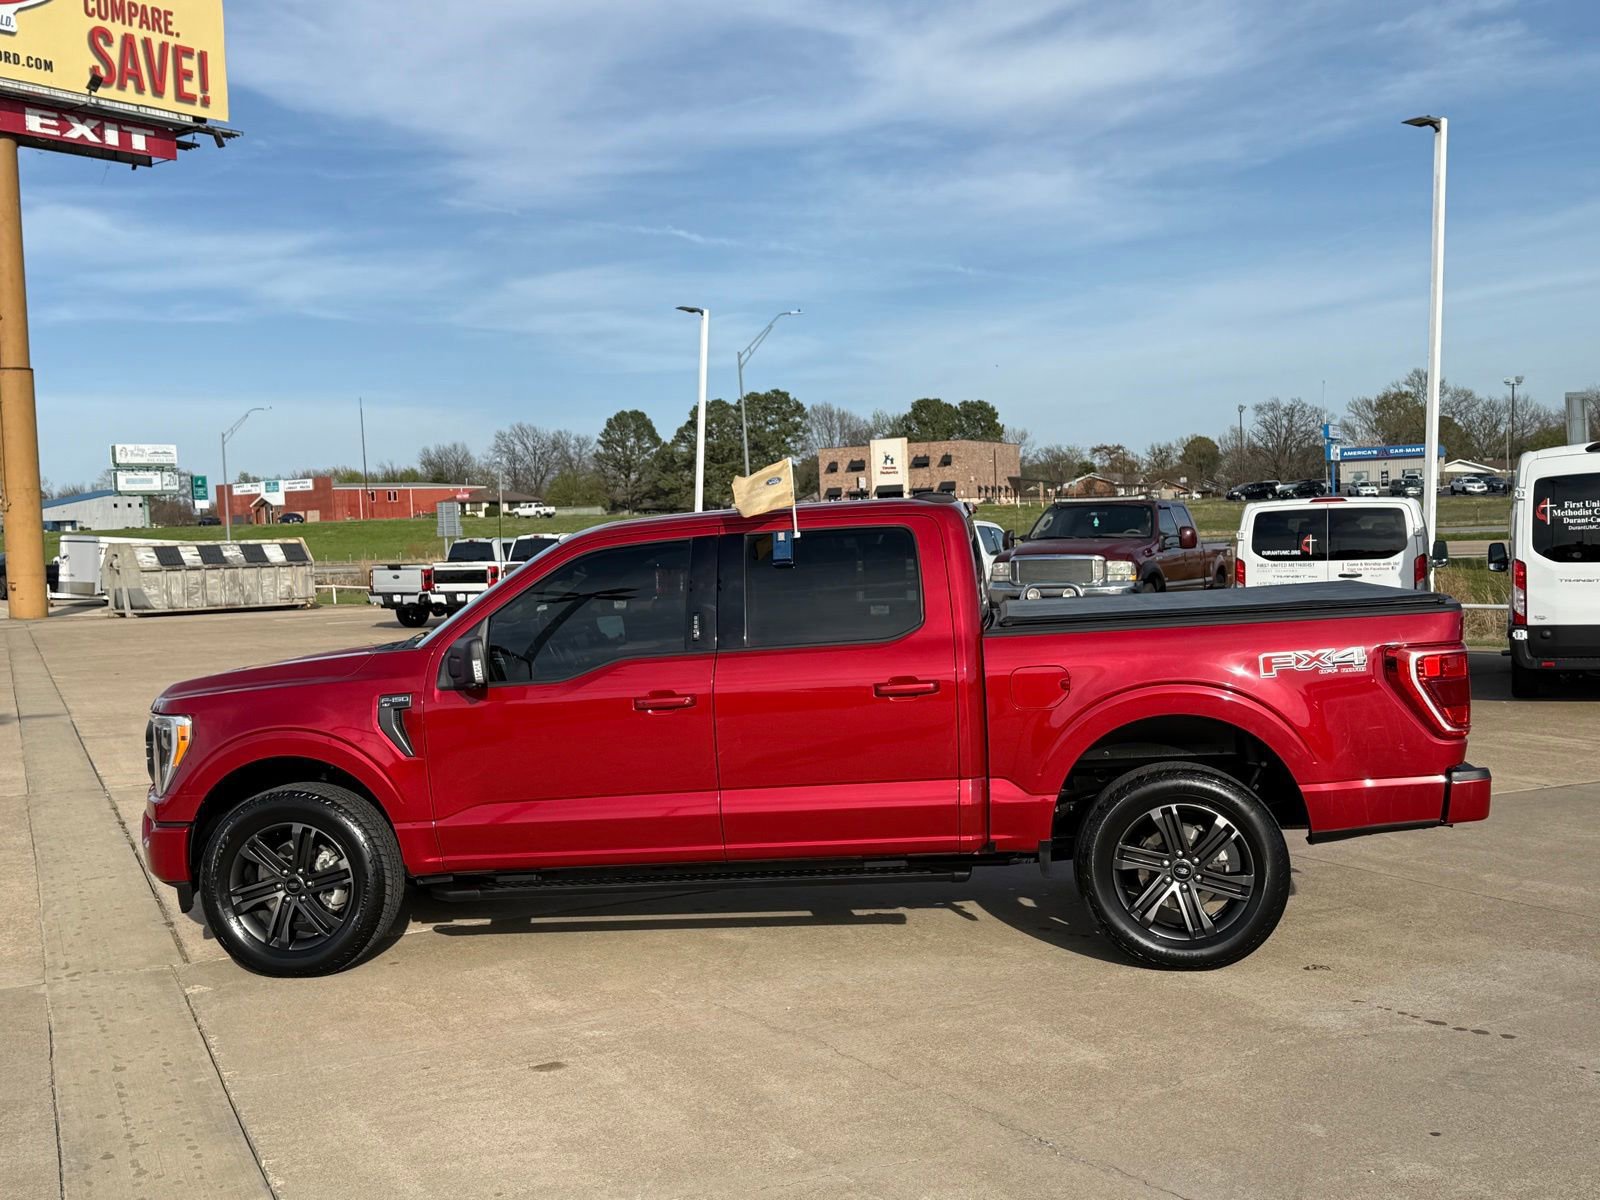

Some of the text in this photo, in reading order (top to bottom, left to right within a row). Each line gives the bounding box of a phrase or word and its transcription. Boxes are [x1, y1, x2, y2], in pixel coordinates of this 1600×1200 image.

[84, 0, 180, 37] COMPARE.
[90, 26, 211, 106] SAVE!
[25, 106, 156, 151] EXIT
[1258, 646, 1368, 679] FX4
